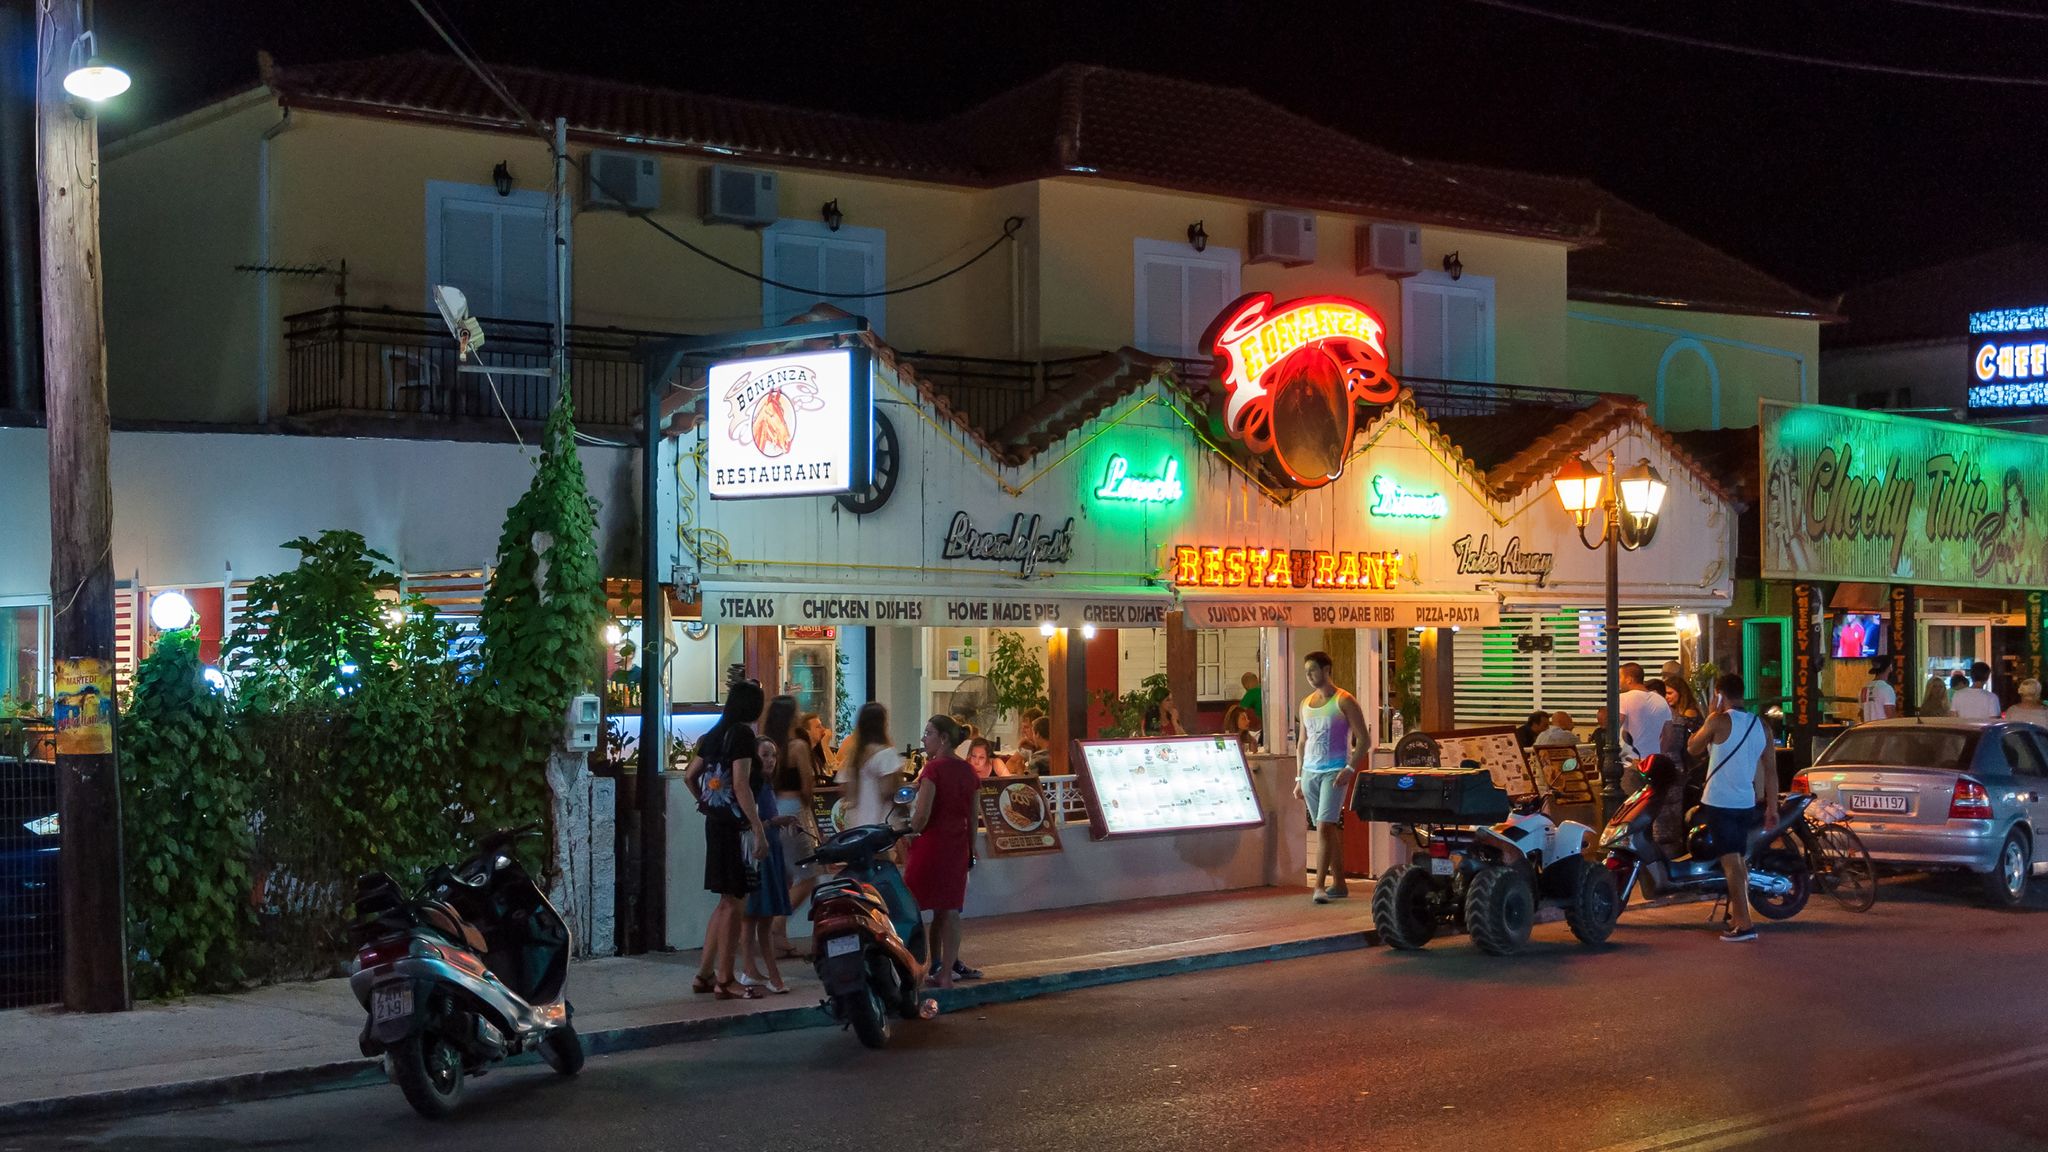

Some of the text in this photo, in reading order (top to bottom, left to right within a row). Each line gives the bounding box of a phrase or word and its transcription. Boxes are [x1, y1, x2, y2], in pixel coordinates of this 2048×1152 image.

[1240, 304, 1372, 383] BONANZA
[1975, 344, 2048, 381] CHEE
[736, 369, 808, 412] BONANZA
[716, 462, 832, 485] RESTAURANT
[1806, 443, 1915, 575] Cheeky
[1926, 450, 1988, 543] Tikis
[942, 510, 1075, 579] Breakfast
[1452, 533, 1553, 588] Take Away
[1175, 545, 1403, 589] RESTAURANT
[719, 598, 775, 618] STEAKS
[802, 599, 869, 619] CHICKEN
[875, 600, 923, 620] DISHES
[948, 602, 988, 621] HOME
[992, 602, 1032, 621] MADE
[1034, 603, 1060, 622] PIES
[1083, 604, 1125, 622] GREEK
[1207, 605, 1480, 625] SUNDAY ROAST BBQ SPARE RIBS PIZZA-PASTA
